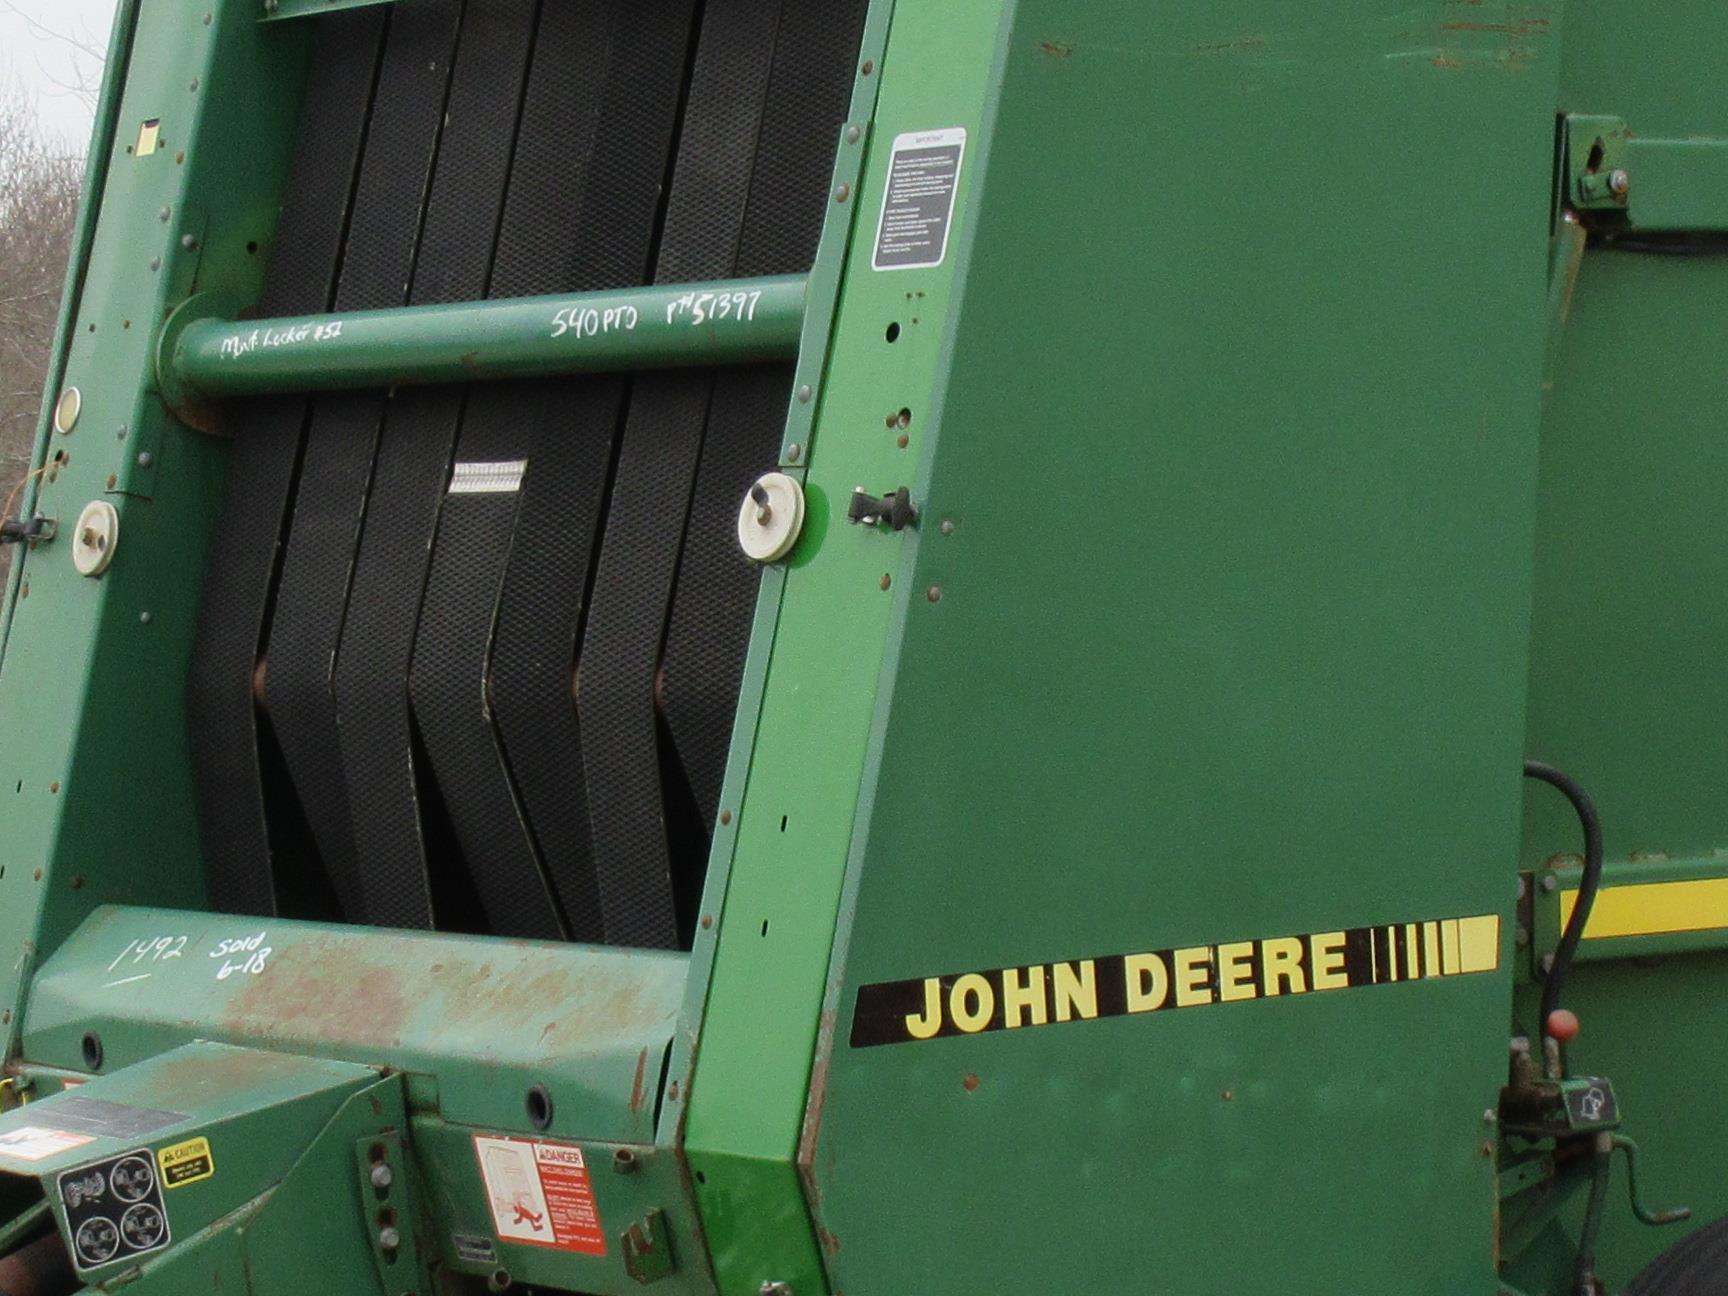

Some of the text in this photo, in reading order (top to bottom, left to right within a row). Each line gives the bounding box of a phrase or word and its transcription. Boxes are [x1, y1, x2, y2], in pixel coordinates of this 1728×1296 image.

[108, 935, 188, 973] 1492
[904, 930, 1351, 1040] JOHN DEERE
[545, 1149, 580, 1164] DANGER
